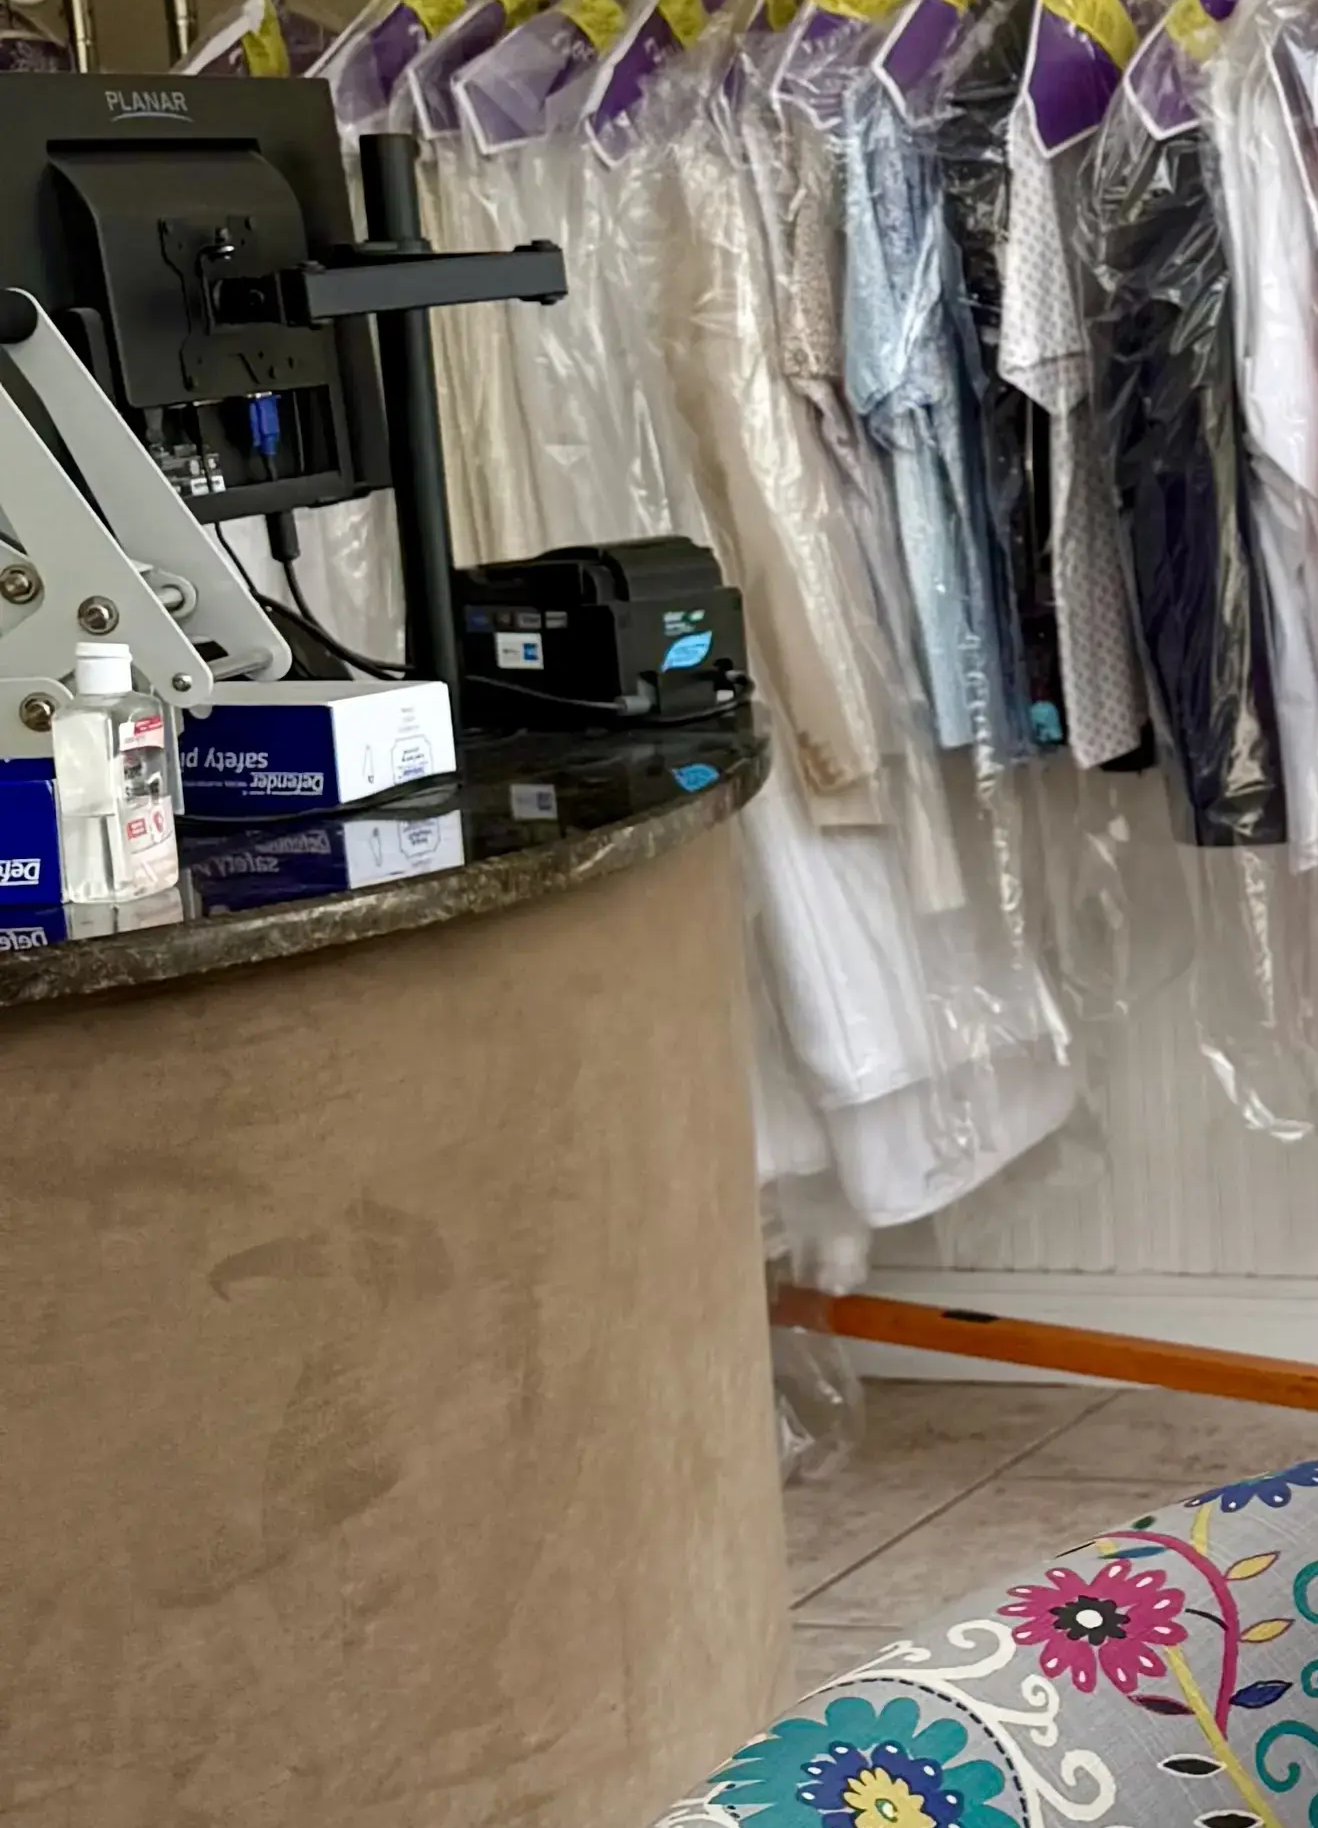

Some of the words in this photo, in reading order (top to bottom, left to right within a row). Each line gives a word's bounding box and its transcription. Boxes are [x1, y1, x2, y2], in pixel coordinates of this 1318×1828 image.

[105, 90, 189, 111] PLANAR
[204, 747, 269, 772] safety
[250, 772, 324, 789] Defender
